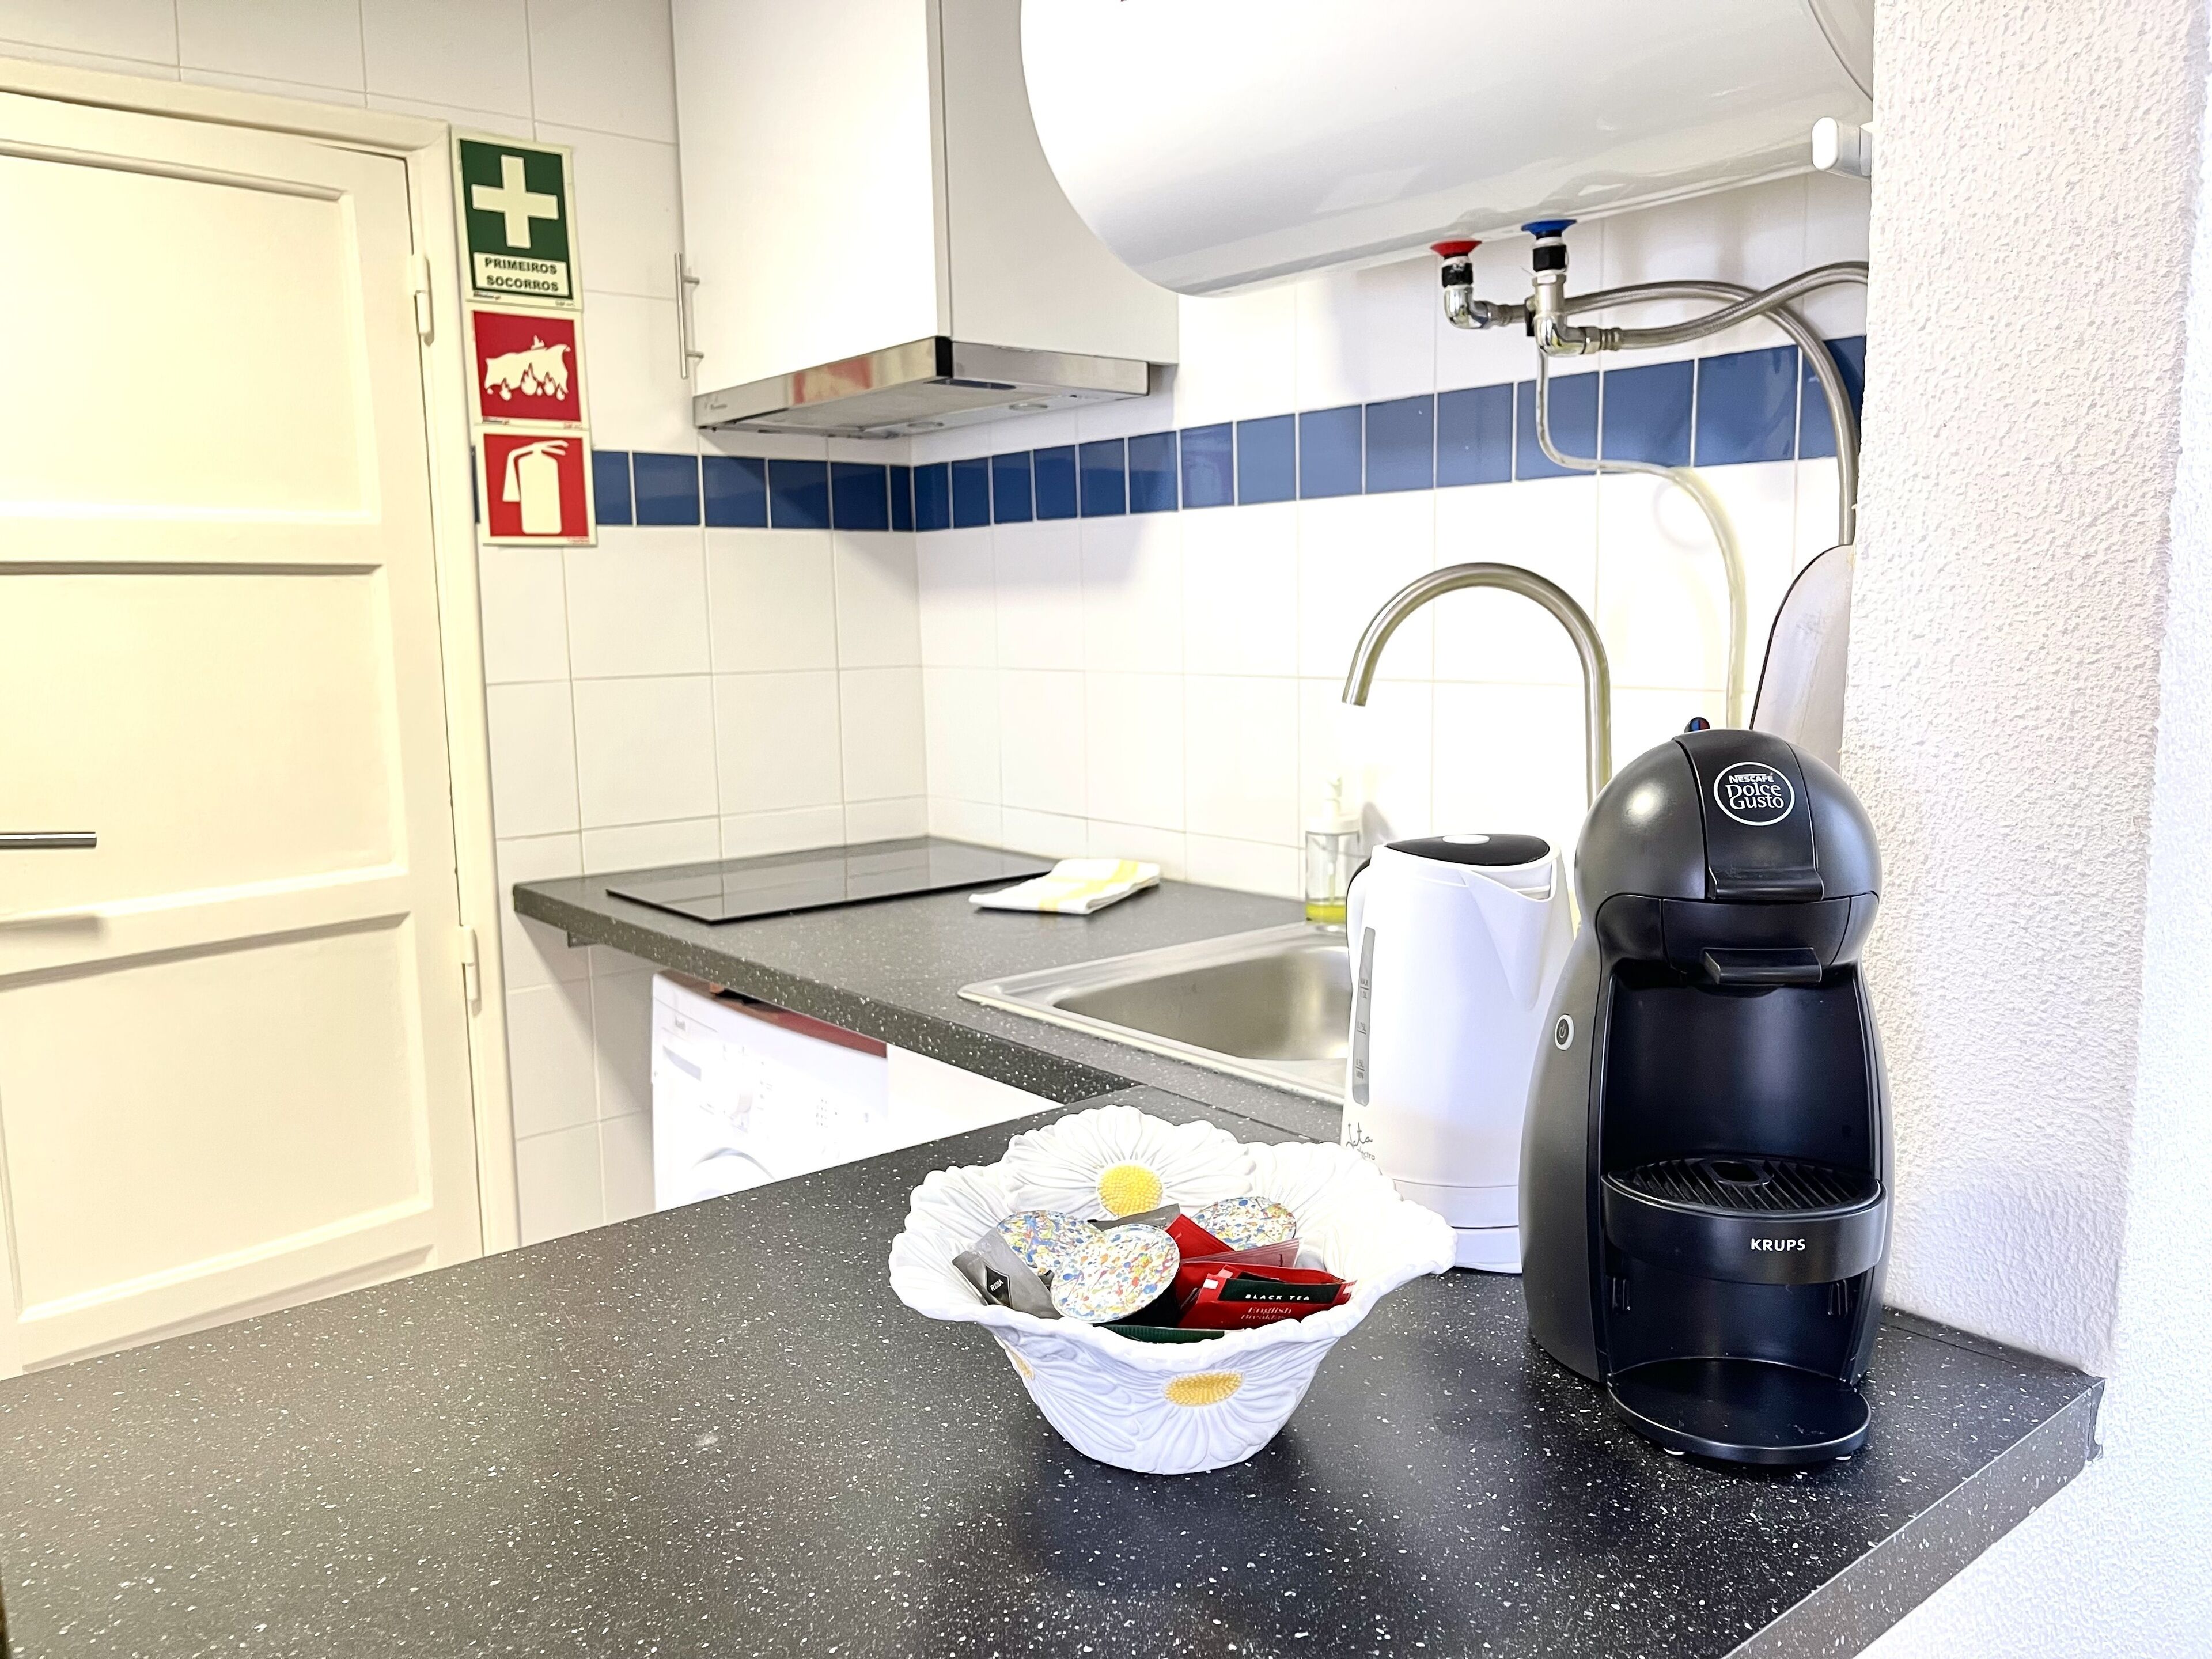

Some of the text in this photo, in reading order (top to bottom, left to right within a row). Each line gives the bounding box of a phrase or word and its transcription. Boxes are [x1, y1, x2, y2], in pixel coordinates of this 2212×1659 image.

[484, 257, 557, 274] PRIMEIROS
[486, 275, 558, 291] SOCORROS
[1725, 782, 1782, 798] Dolce
[1729, 794, 1785, 809] Gusto
[1357, 1146, 1376, 1160] lctro
[1751, 1238, 1805, 1251] KRUPS
